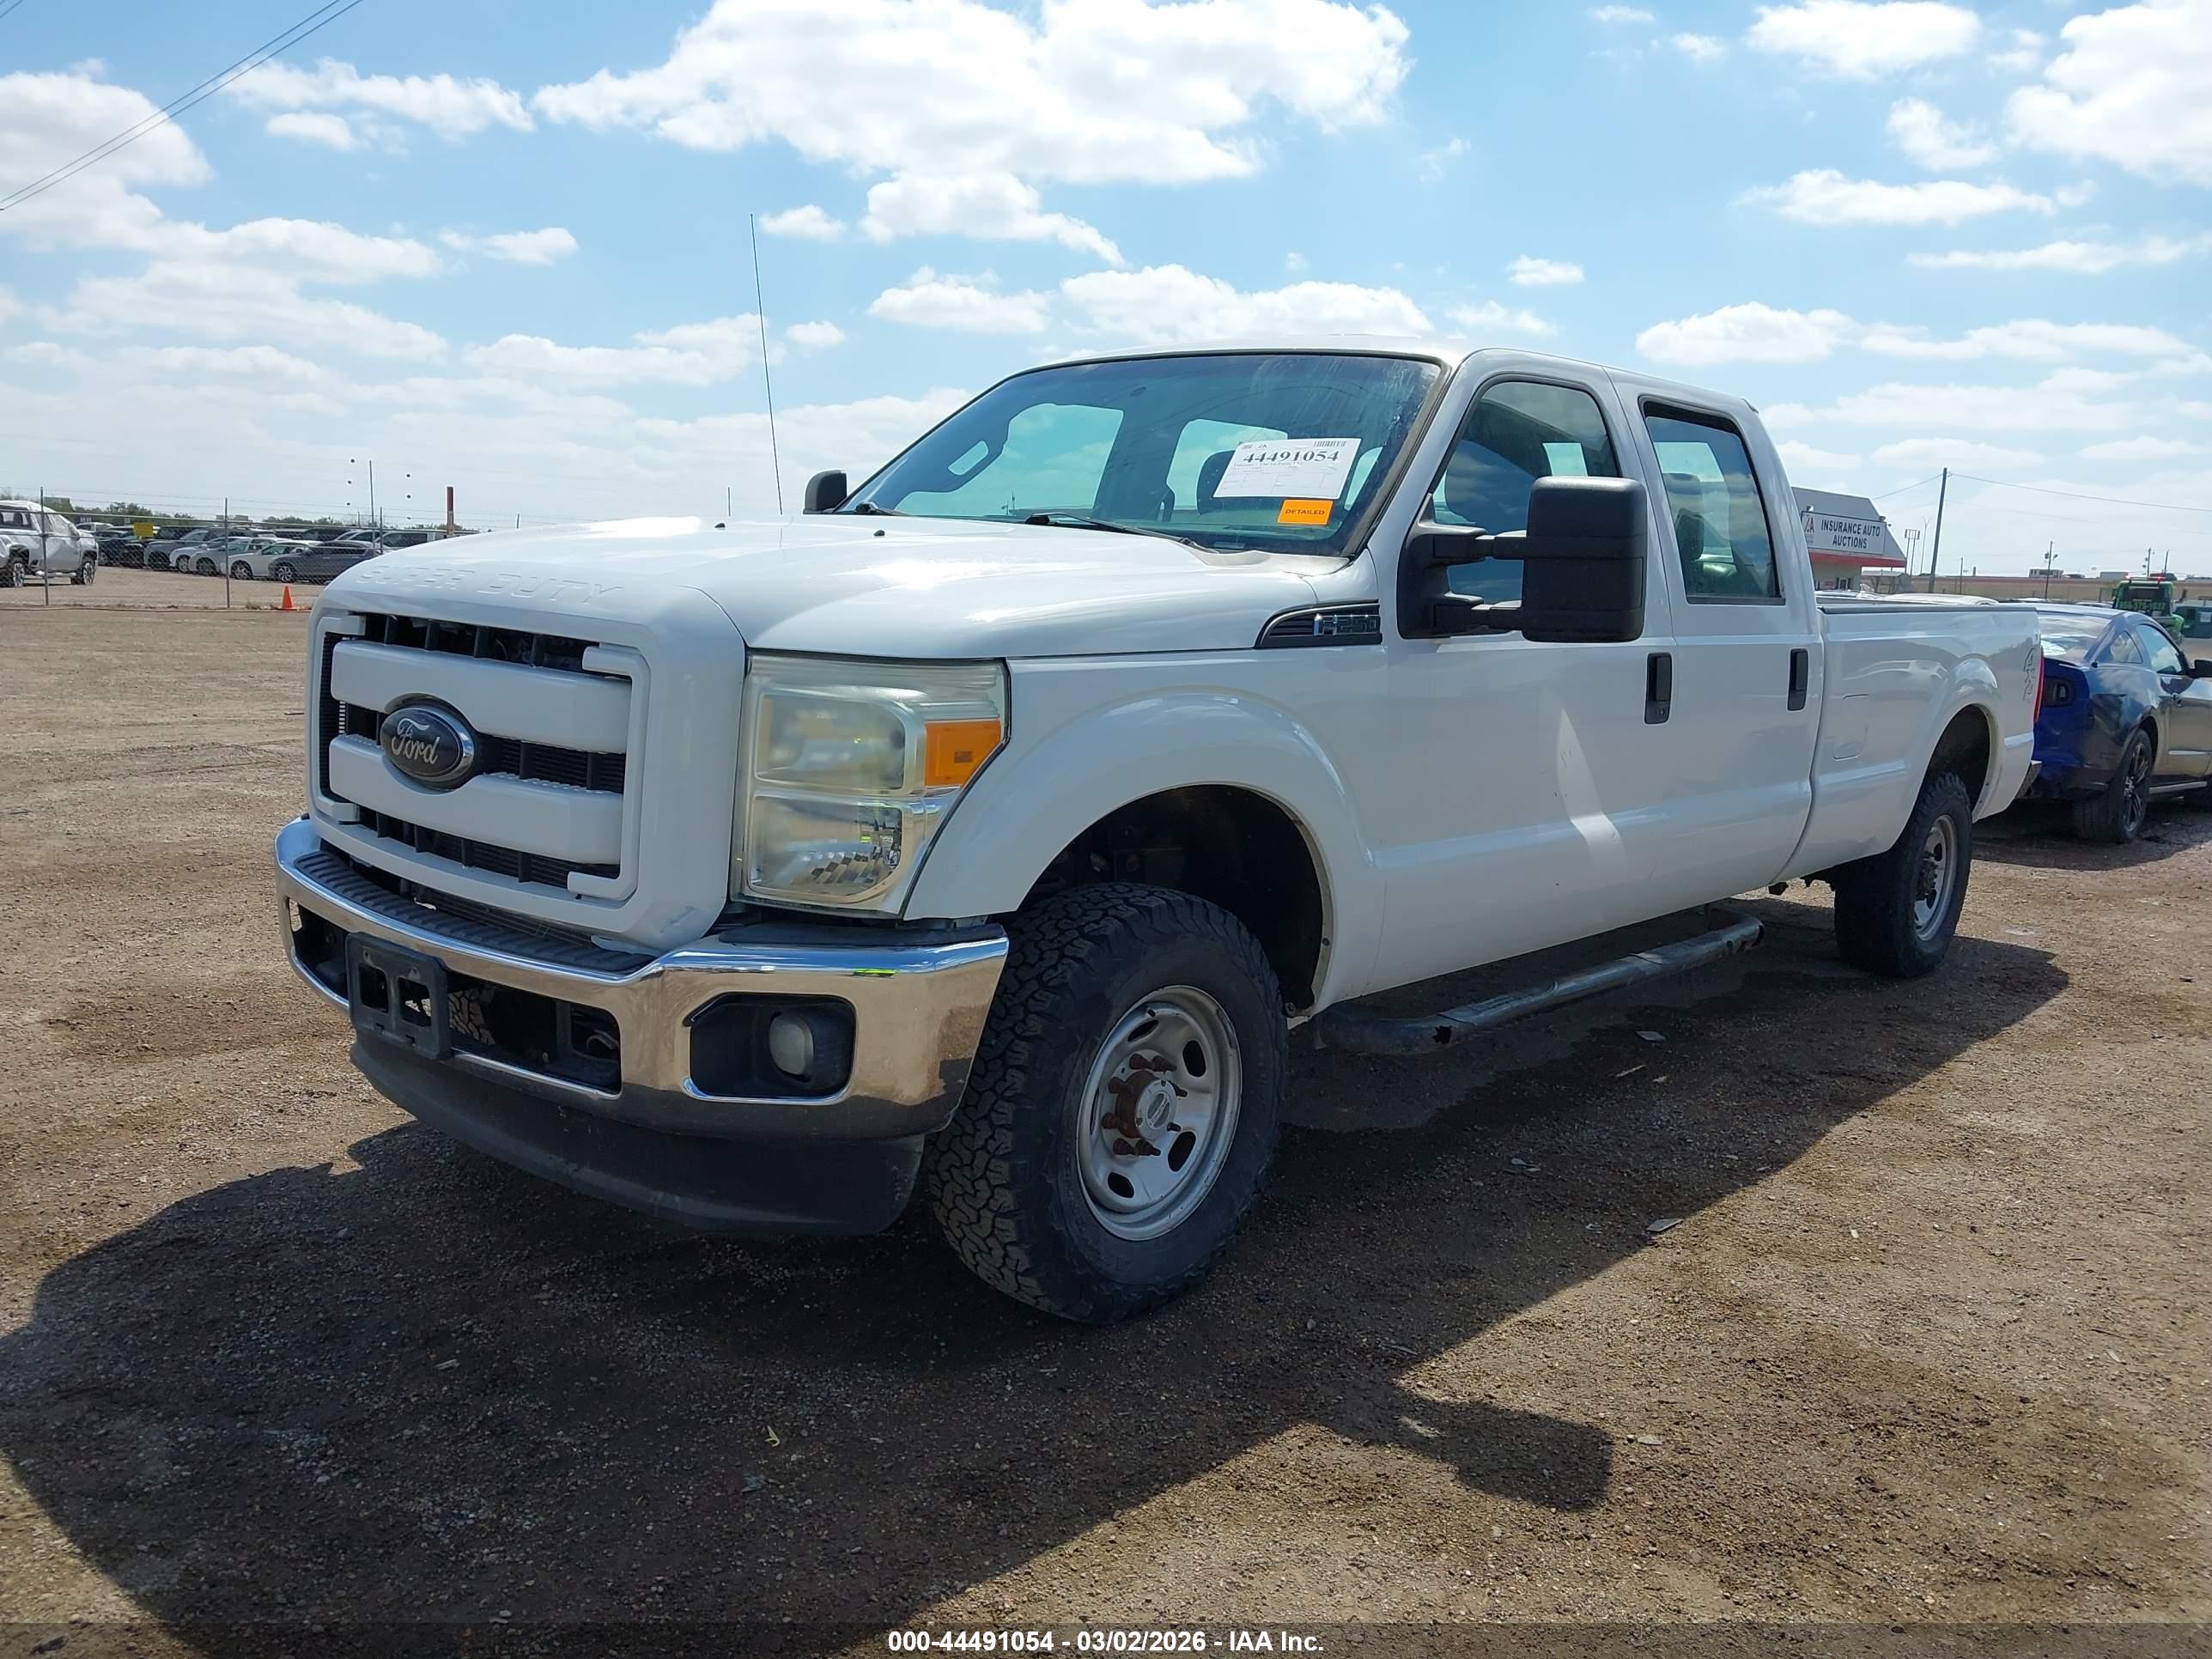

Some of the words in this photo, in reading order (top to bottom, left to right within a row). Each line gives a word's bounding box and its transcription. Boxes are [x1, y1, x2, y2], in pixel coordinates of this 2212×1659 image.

[1243, 450, 1340, 463] 44491054
[1820, 519, 1862, 535] INSURANCE
[1863, 525, 1881, 537] AUTO
[1832, 535, 1868, 549] AUCTIONS
[477, 573, 625, 605] DUTY
[391, 718, 440, 765] Ford
